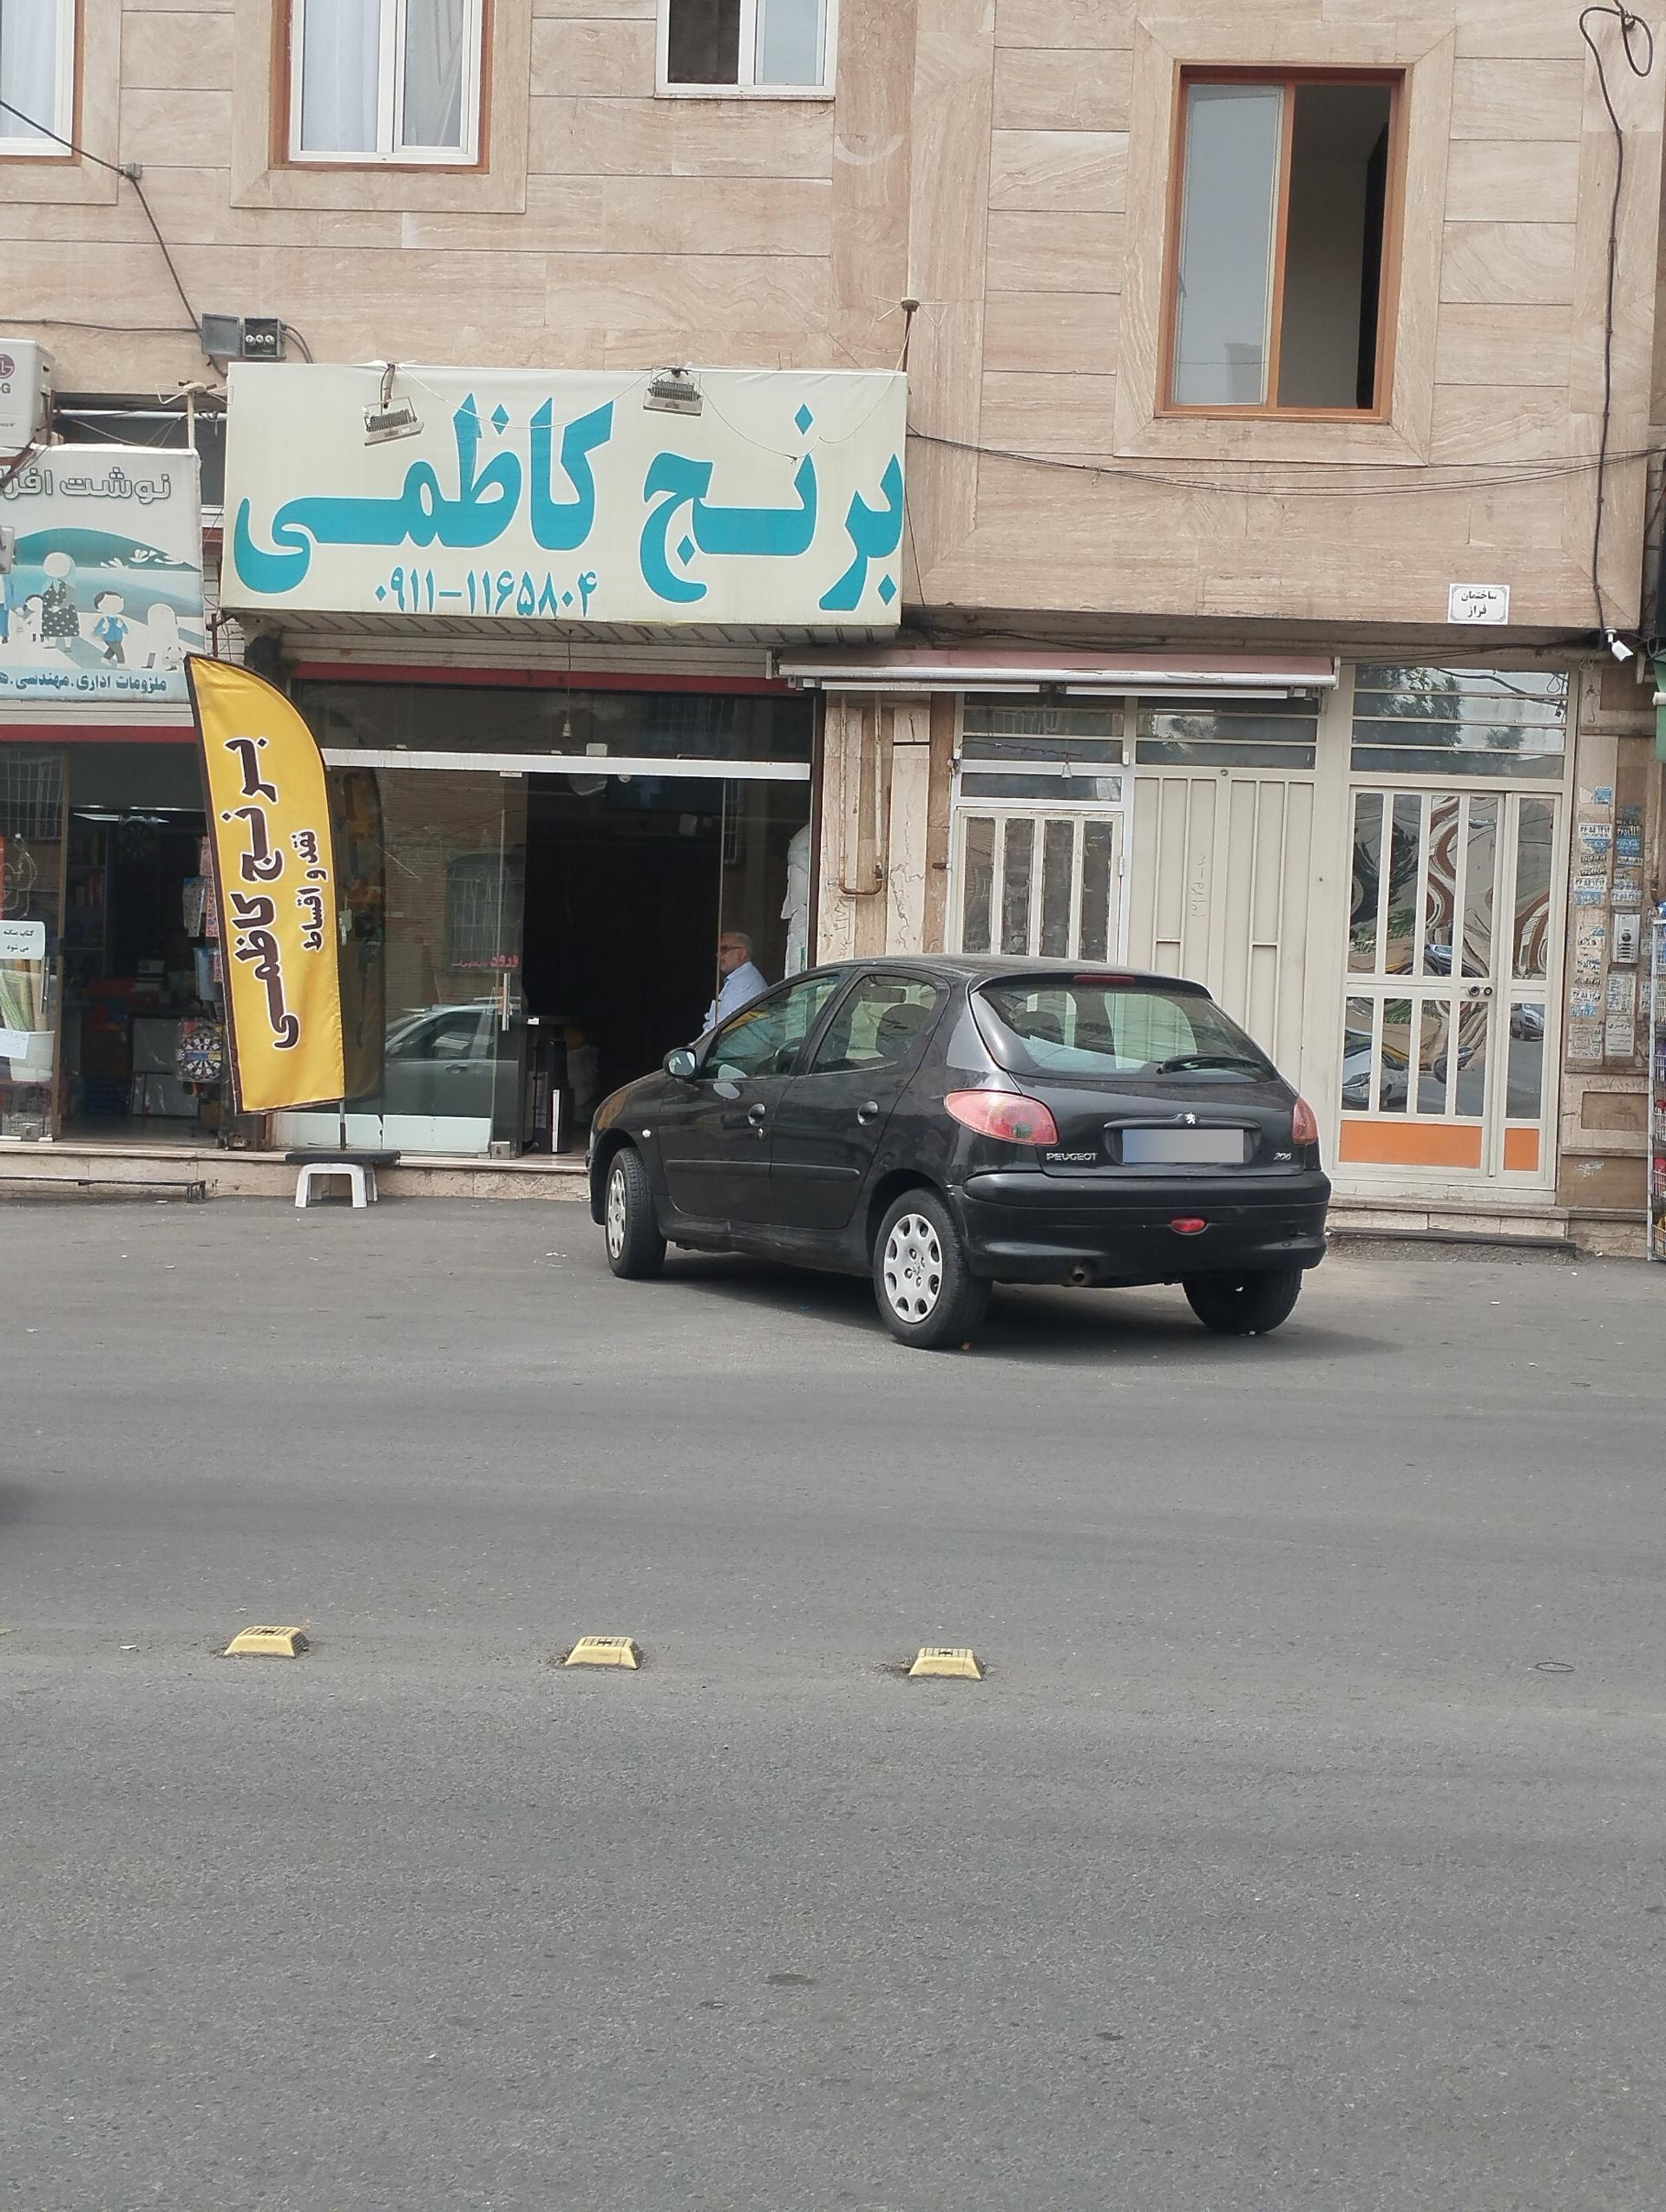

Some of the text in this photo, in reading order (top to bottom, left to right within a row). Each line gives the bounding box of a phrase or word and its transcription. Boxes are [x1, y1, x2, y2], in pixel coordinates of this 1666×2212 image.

[60, 467, 171, 505] نوشت
[233, 391, 903, 611] برنج کاظمی
[374, 565, 599, 618] ۰۹۱۱-۱۱۶۵۸۰۴
[1460, 590, 1497, 602] ساختمان
[115, 674, 167, 695] ملزومات
[221, 736, 301, 1050] برنج کاظمی
[291, 829, 328, 952] نقد و اقساط
[1046, 1151, 1099, 1162] PEUGEOT
[1273, 1151, 1292, 1162] 206
